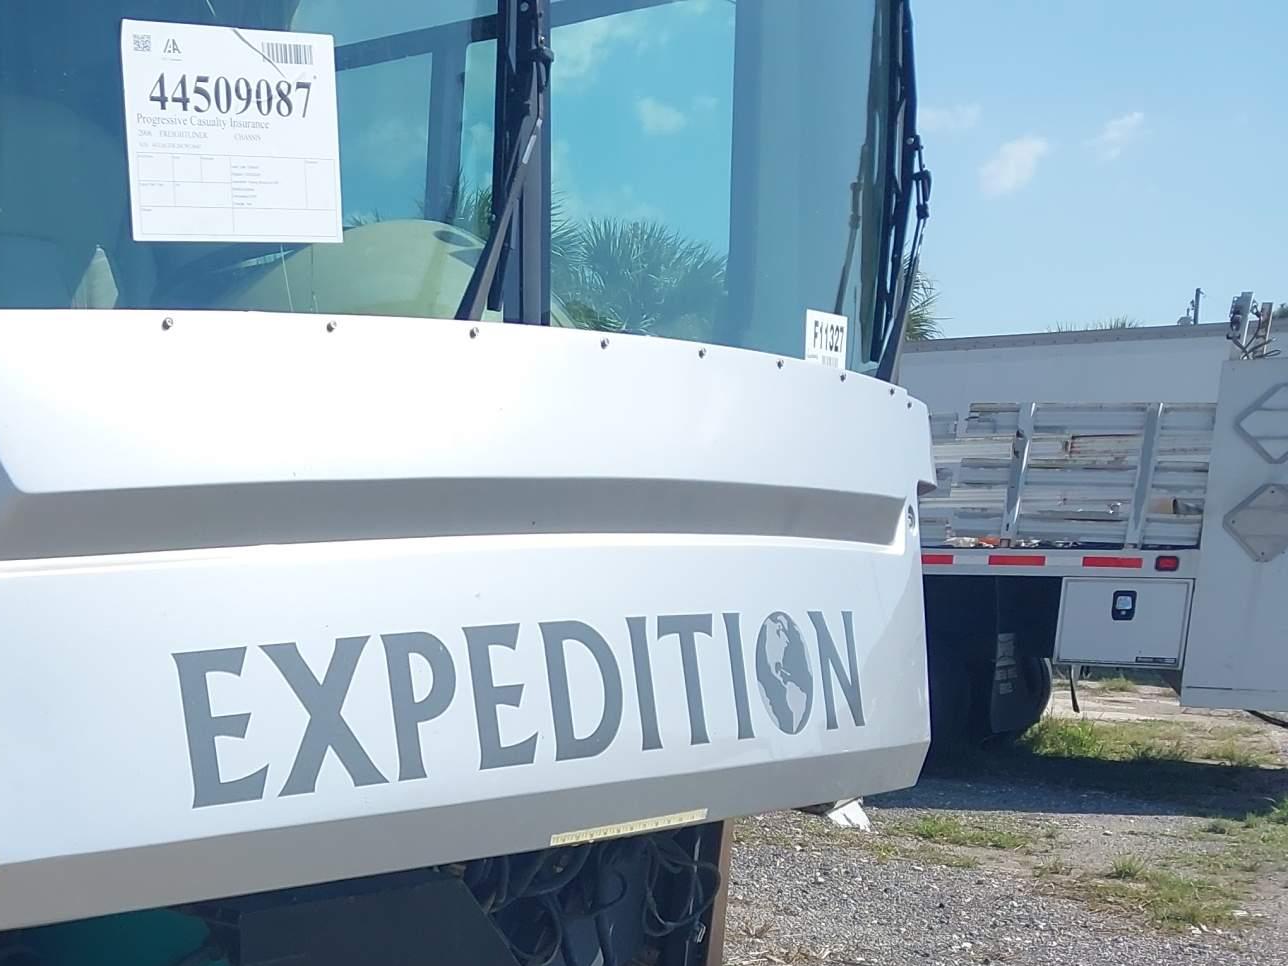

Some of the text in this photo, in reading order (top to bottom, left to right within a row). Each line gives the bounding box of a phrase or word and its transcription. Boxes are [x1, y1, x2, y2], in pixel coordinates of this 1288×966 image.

[149, 72, 312, 118] 44509087
[136, 113, 270, 130] Progressive Casualty Insurance
[813, 320, 845, 353] F11327
[171, 611, 866, 809] EXPEDITION
